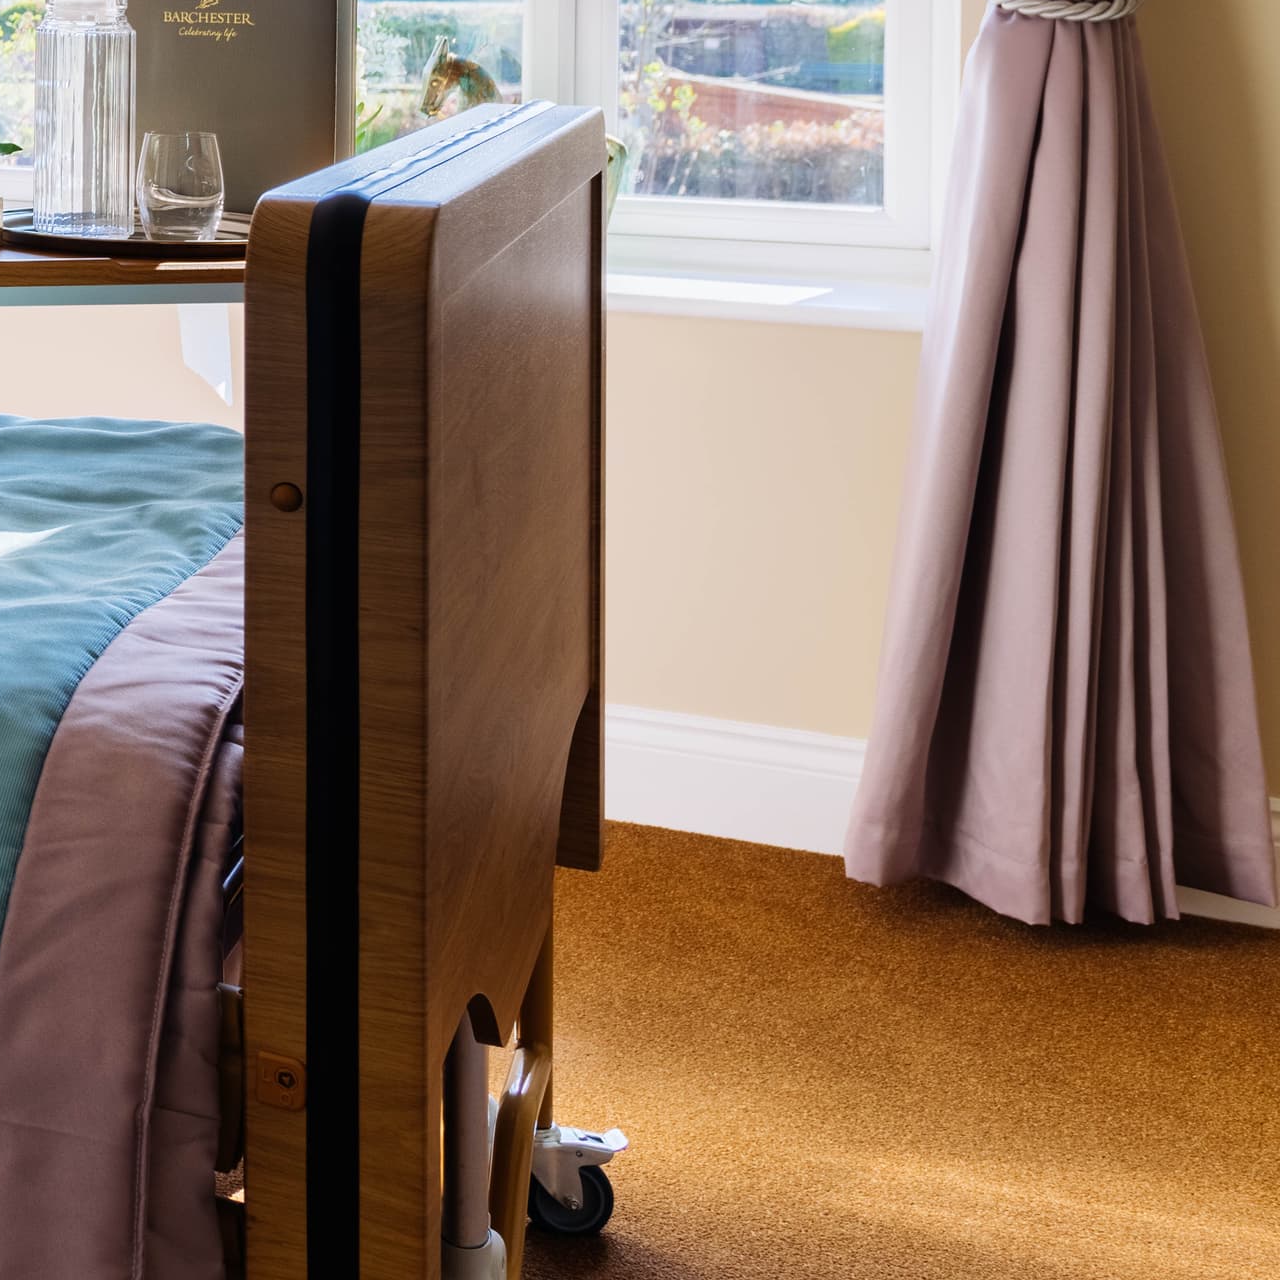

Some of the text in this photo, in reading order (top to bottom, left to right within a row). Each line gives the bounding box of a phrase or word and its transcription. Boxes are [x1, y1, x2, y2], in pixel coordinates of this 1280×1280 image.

[163, 11, 255, 26] BARCHESTER
[178, 26, 238, 42] Celebrating life
